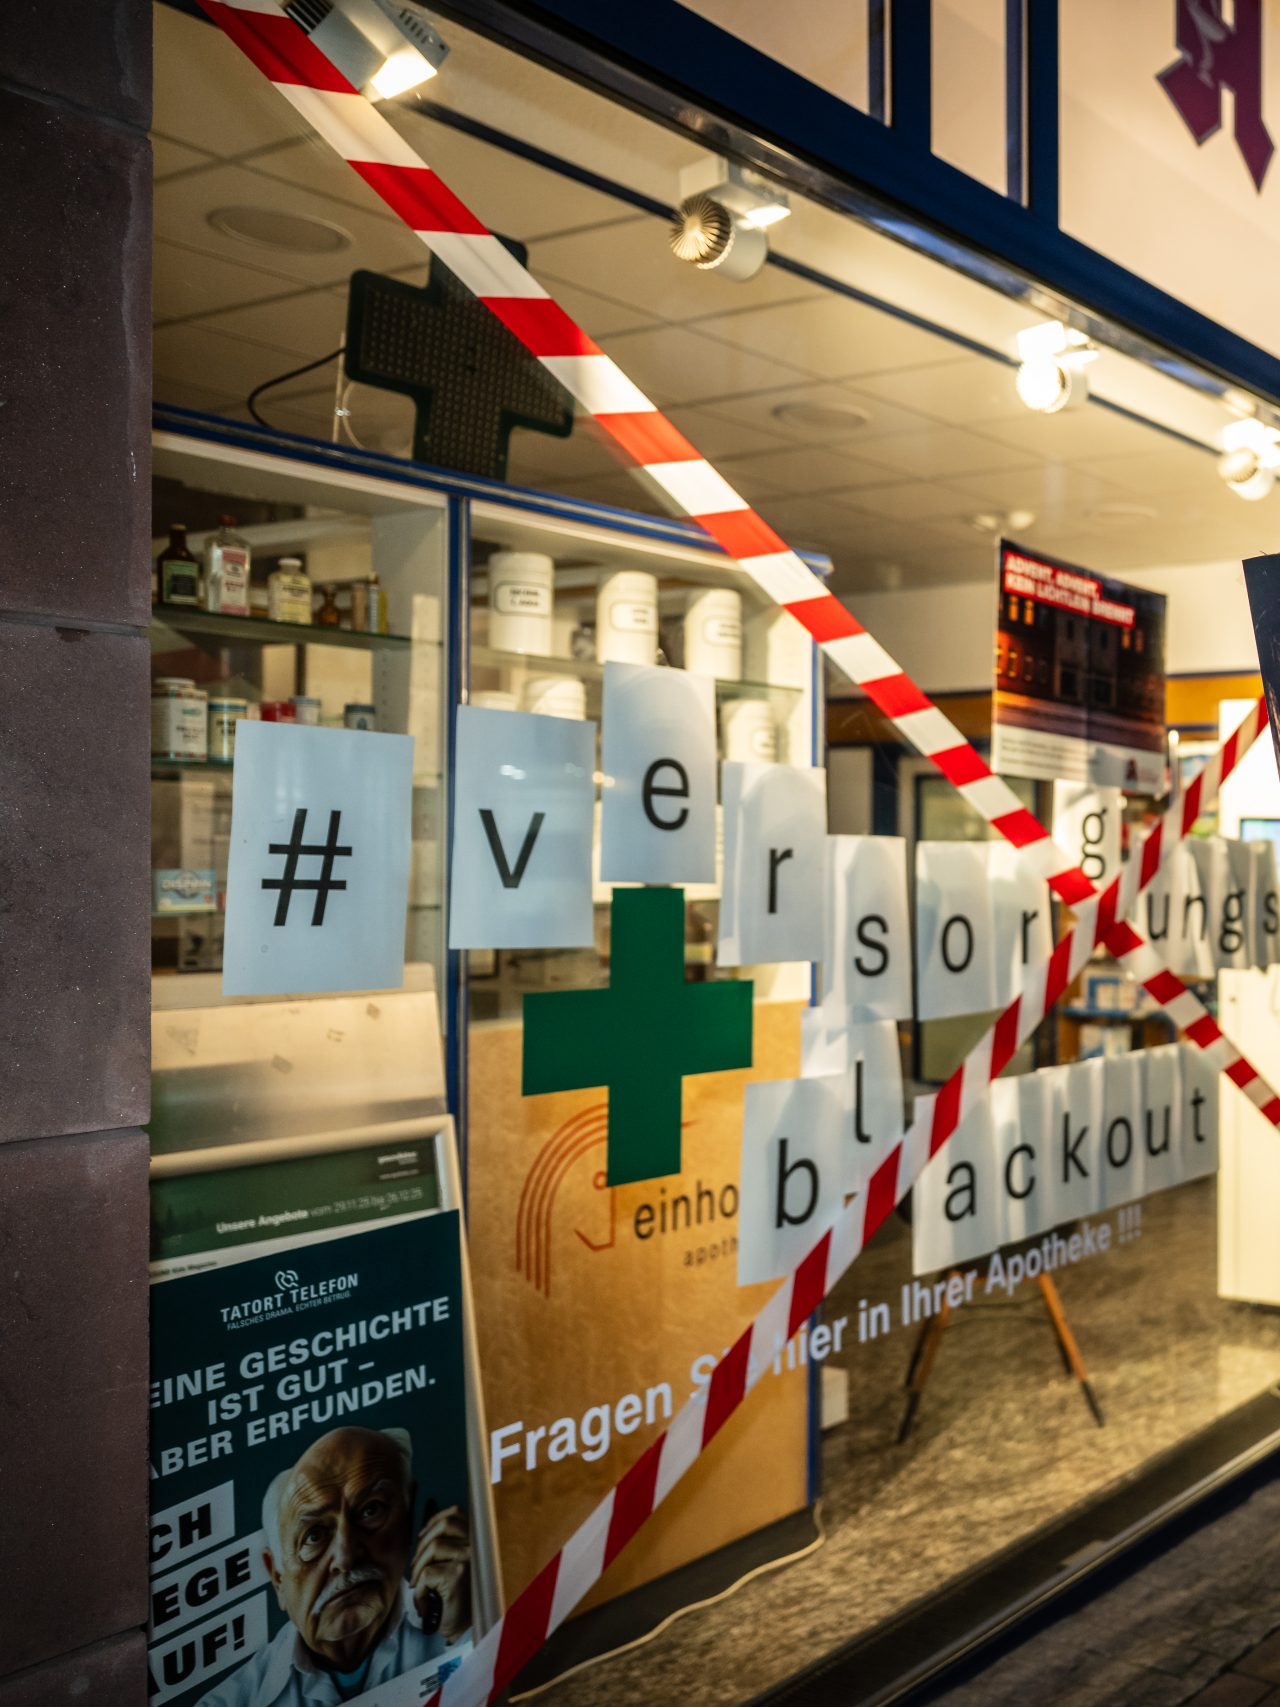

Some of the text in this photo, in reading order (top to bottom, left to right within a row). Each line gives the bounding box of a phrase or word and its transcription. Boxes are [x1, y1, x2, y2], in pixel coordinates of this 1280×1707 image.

[216, 1218, 256, 1234] Unsere
[258, 1208, 309, 1227] Angebote
[220, 1273, 359, 1323] TATORT TELEFON
[227, 1314, 265, 1331] FALSCHES
[239, 1296, 450, 1380] GESCHICHTE
[490, 1382, 672, 1485] Fragen
[859, 1299, 891, 1343] in
[902, 1268, 978, 1327] Ihrer
[984, 1222, 1112, 1296] Apotheke
[208, 1385, 265, 1425] IST
[276, 1358, 348, 1401] GUT
[246, 1364, 436, 1447] ERFUNDEN.
